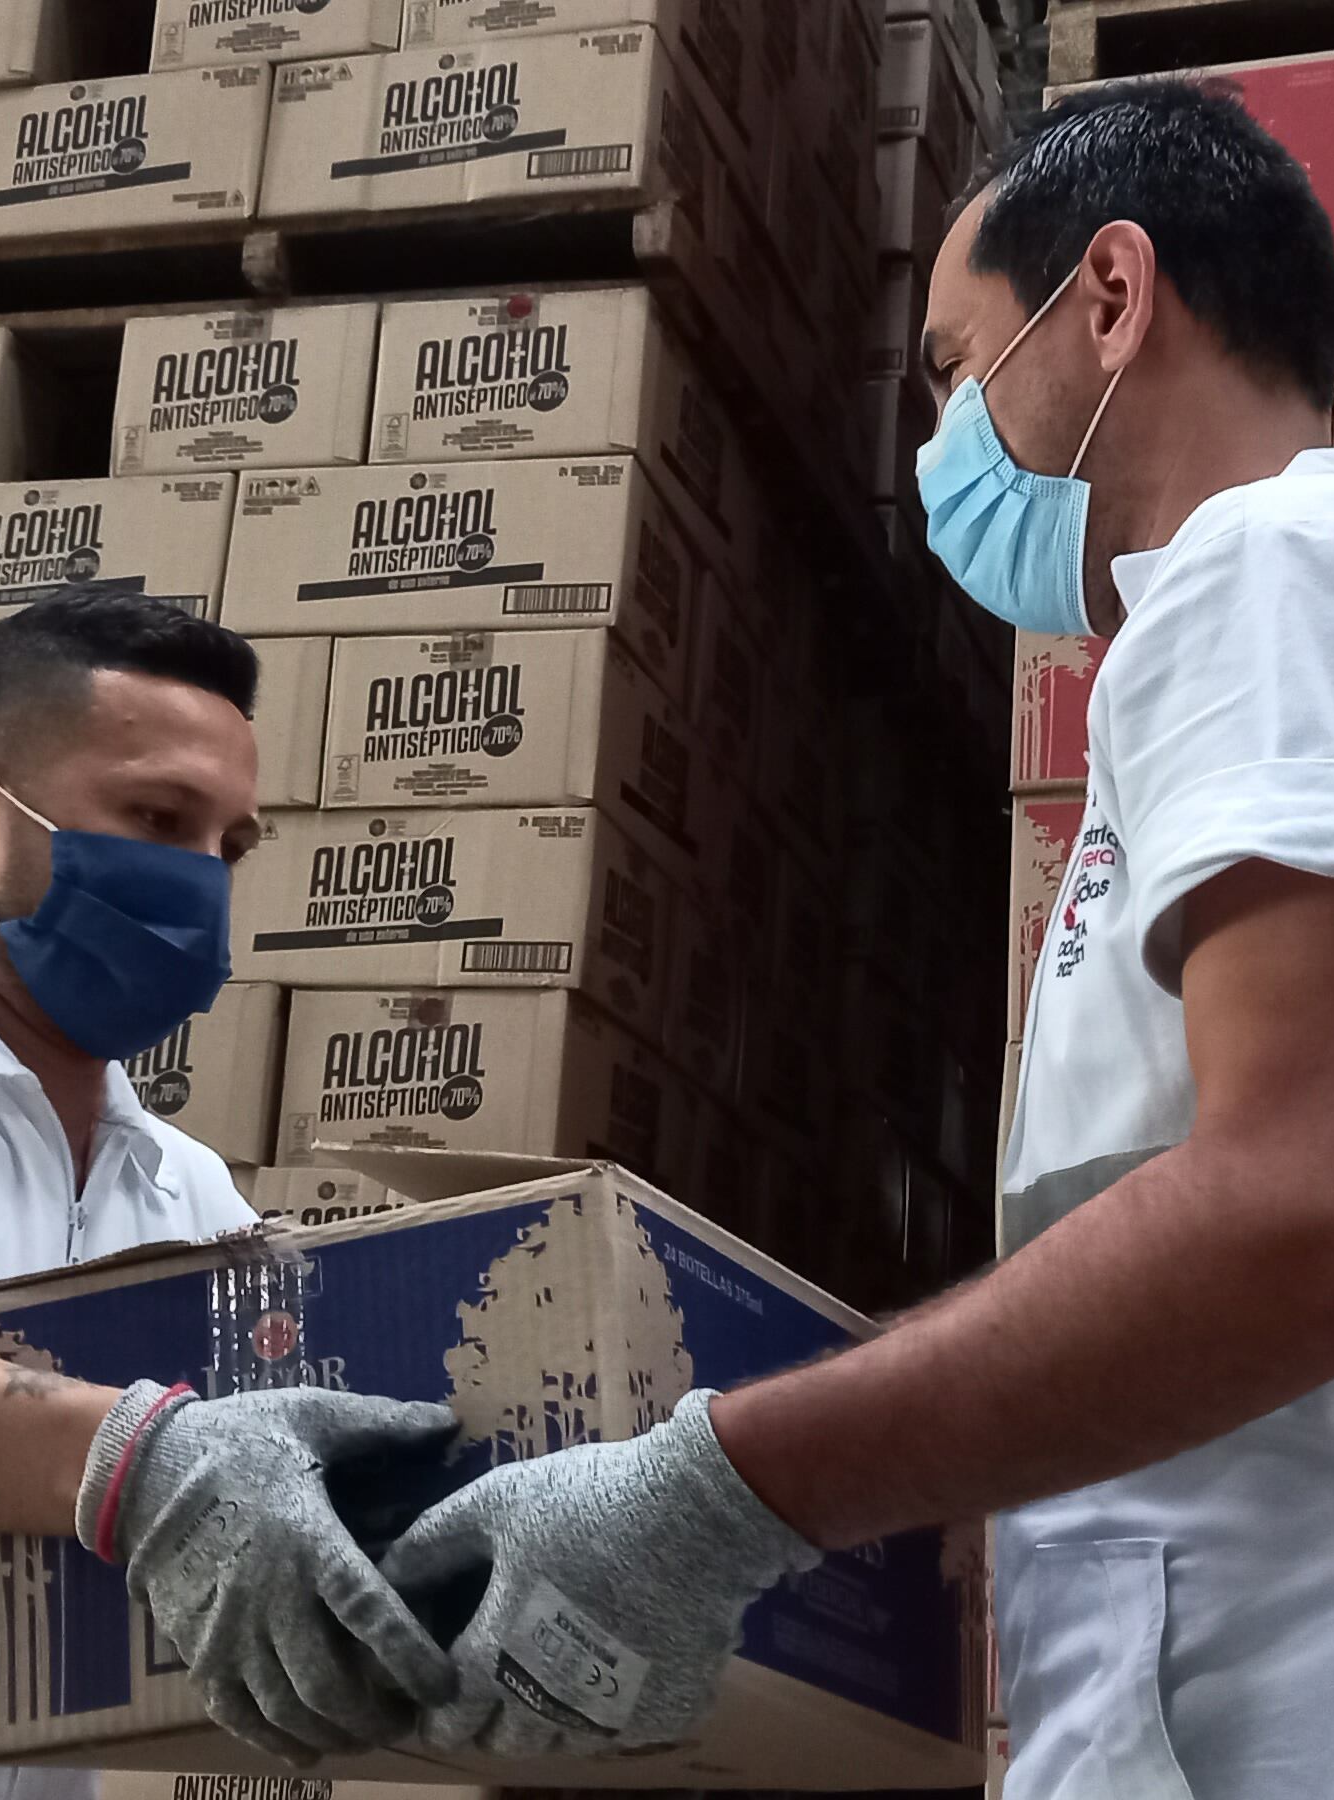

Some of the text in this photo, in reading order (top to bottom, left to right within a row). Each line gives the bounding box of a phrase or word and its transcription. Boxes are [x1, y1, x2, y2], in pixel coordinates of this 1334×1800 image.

[382, 61, 521, 129] ALCOHOL
[15, 95, 148, 158] ALCOHOL
[380, 115, 483, 155] ANTISÉPTICO
[13, 146, 113, 187] ANTISÉPTICO
[153, 339, 300, 404] ALCOHOL
[415, 324, 571, 391] ALCOHOL
[149, 394, 259, 434] ANTISÉPTICO
[412, 380, 529, 421] ANTISÉPTICO
[352, 488, 497, 548] ALCOHOL
[348, 537, 457, 577] ANTISÉPTICO
[367, 664, 525, 733] ALCOHOL
[364, 724, 481, 764] ANTISÉPTICO
[310, 836, 457, 898] ALCOHOL
[306, 889, 416, 928] ANTISÉPTICO
[323, 1022, 485, 1091] ALCOHOL
[320, 1082, 442, 1123] ANTISÉPTICO
